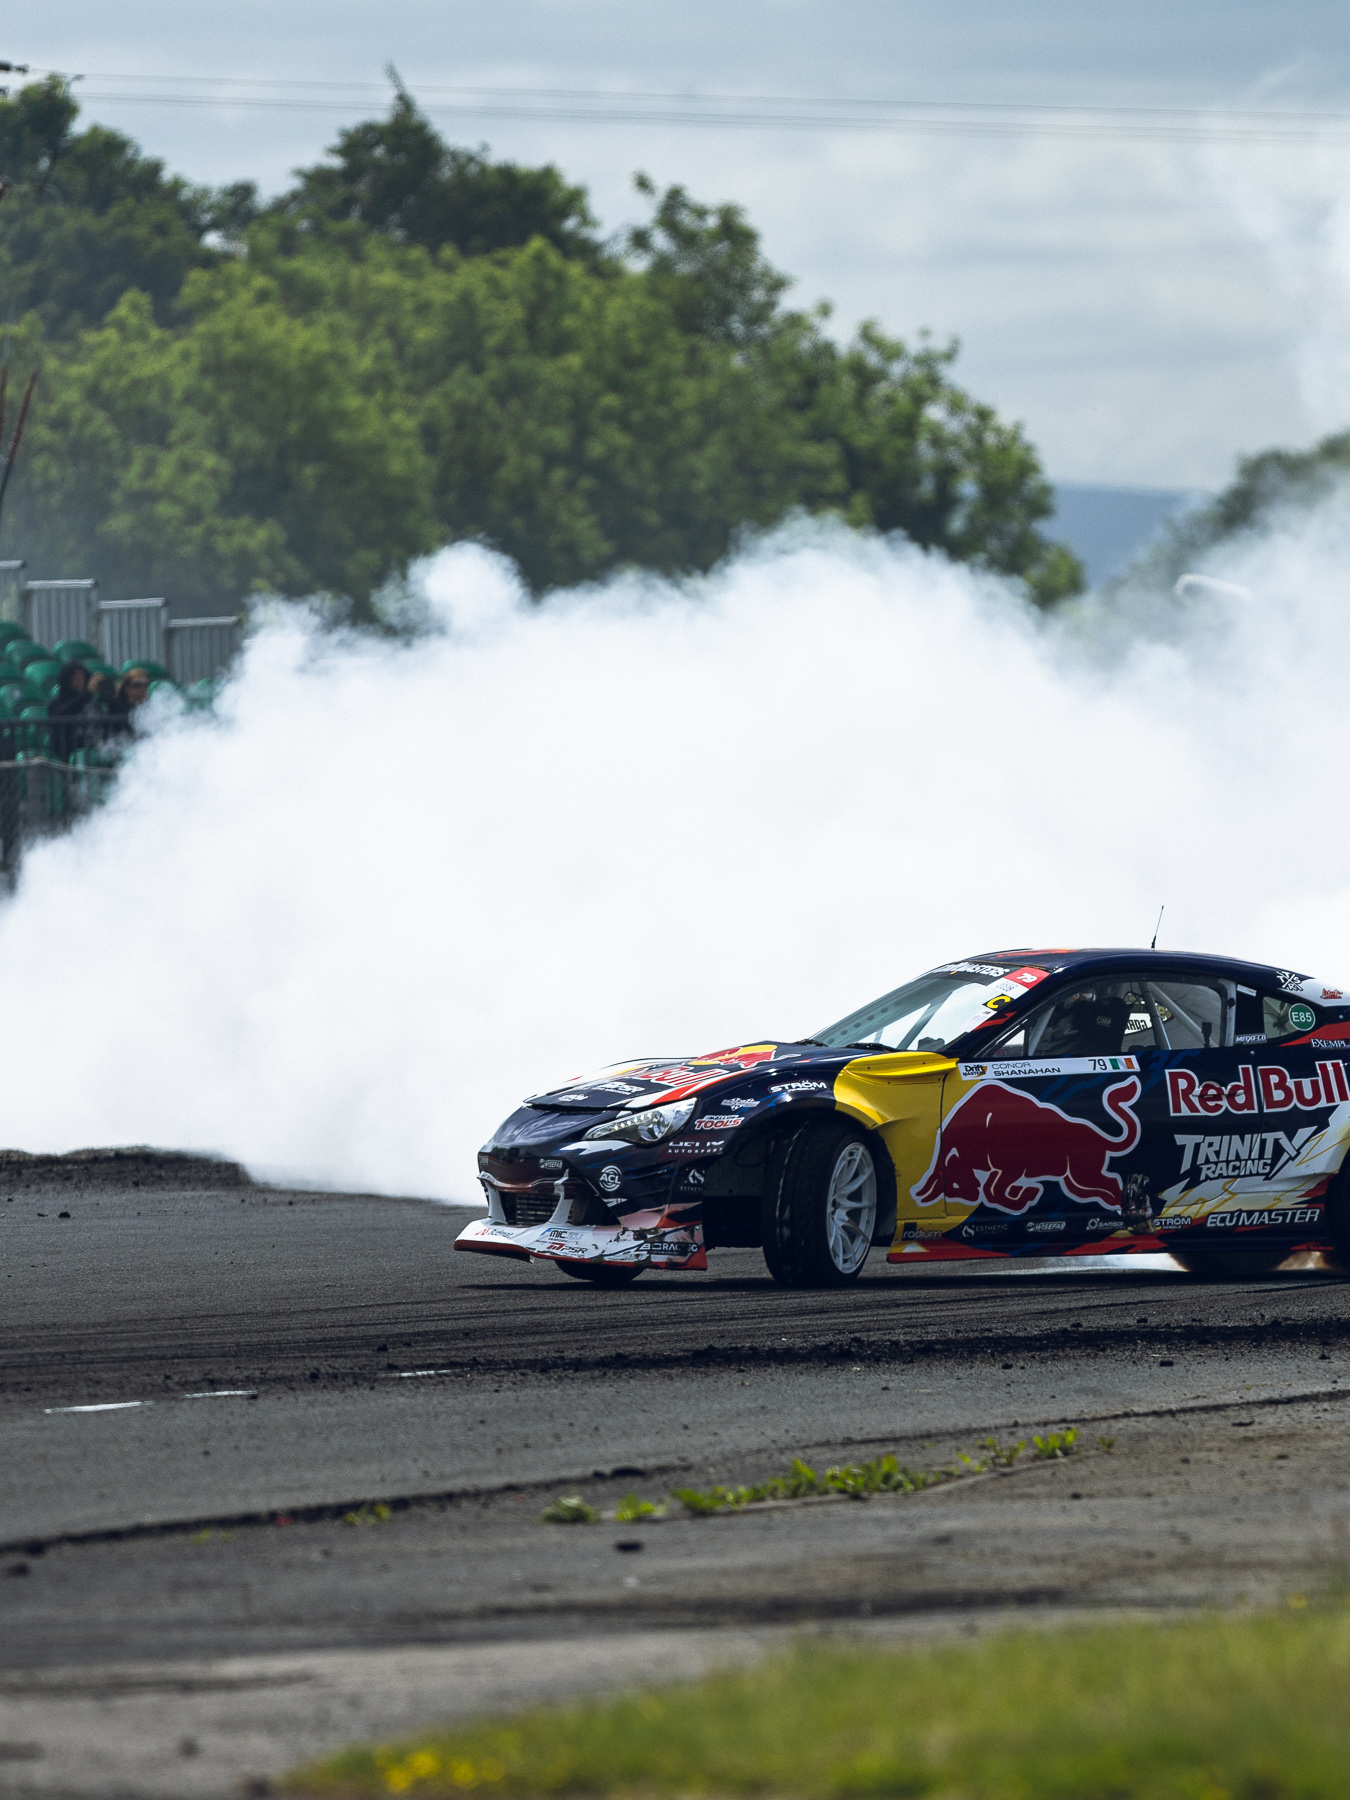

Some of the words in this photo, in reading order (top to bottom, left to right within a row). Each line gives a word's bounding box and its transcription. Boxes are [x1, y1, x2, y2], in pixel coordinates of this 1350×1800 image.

[1292, 1012, 1312, 1022] E85
[1088, 1059, 1107, 1071] 79
[993, 1067, 1061, 1076] SHANAHAN
[770, 1080, 827, 1092] STRÖM
[1165, 1064, 1258, 1116] Red
[1258, 1060, 1350, 1112] Bull
[1174, 1126, 1318, 1179] TRINITY
[1200, 1160, 1271, 1180] RACING
[600, 1174, 621, 1184] ACL
[1153, 1215, 1191, 1226] STRÖM
[1206, 1209, 1320, 1227] ECUMASTER
[1035, 1222, 1066, 1230] WISEFAB
[904, 1229, 941, 1239] radium
